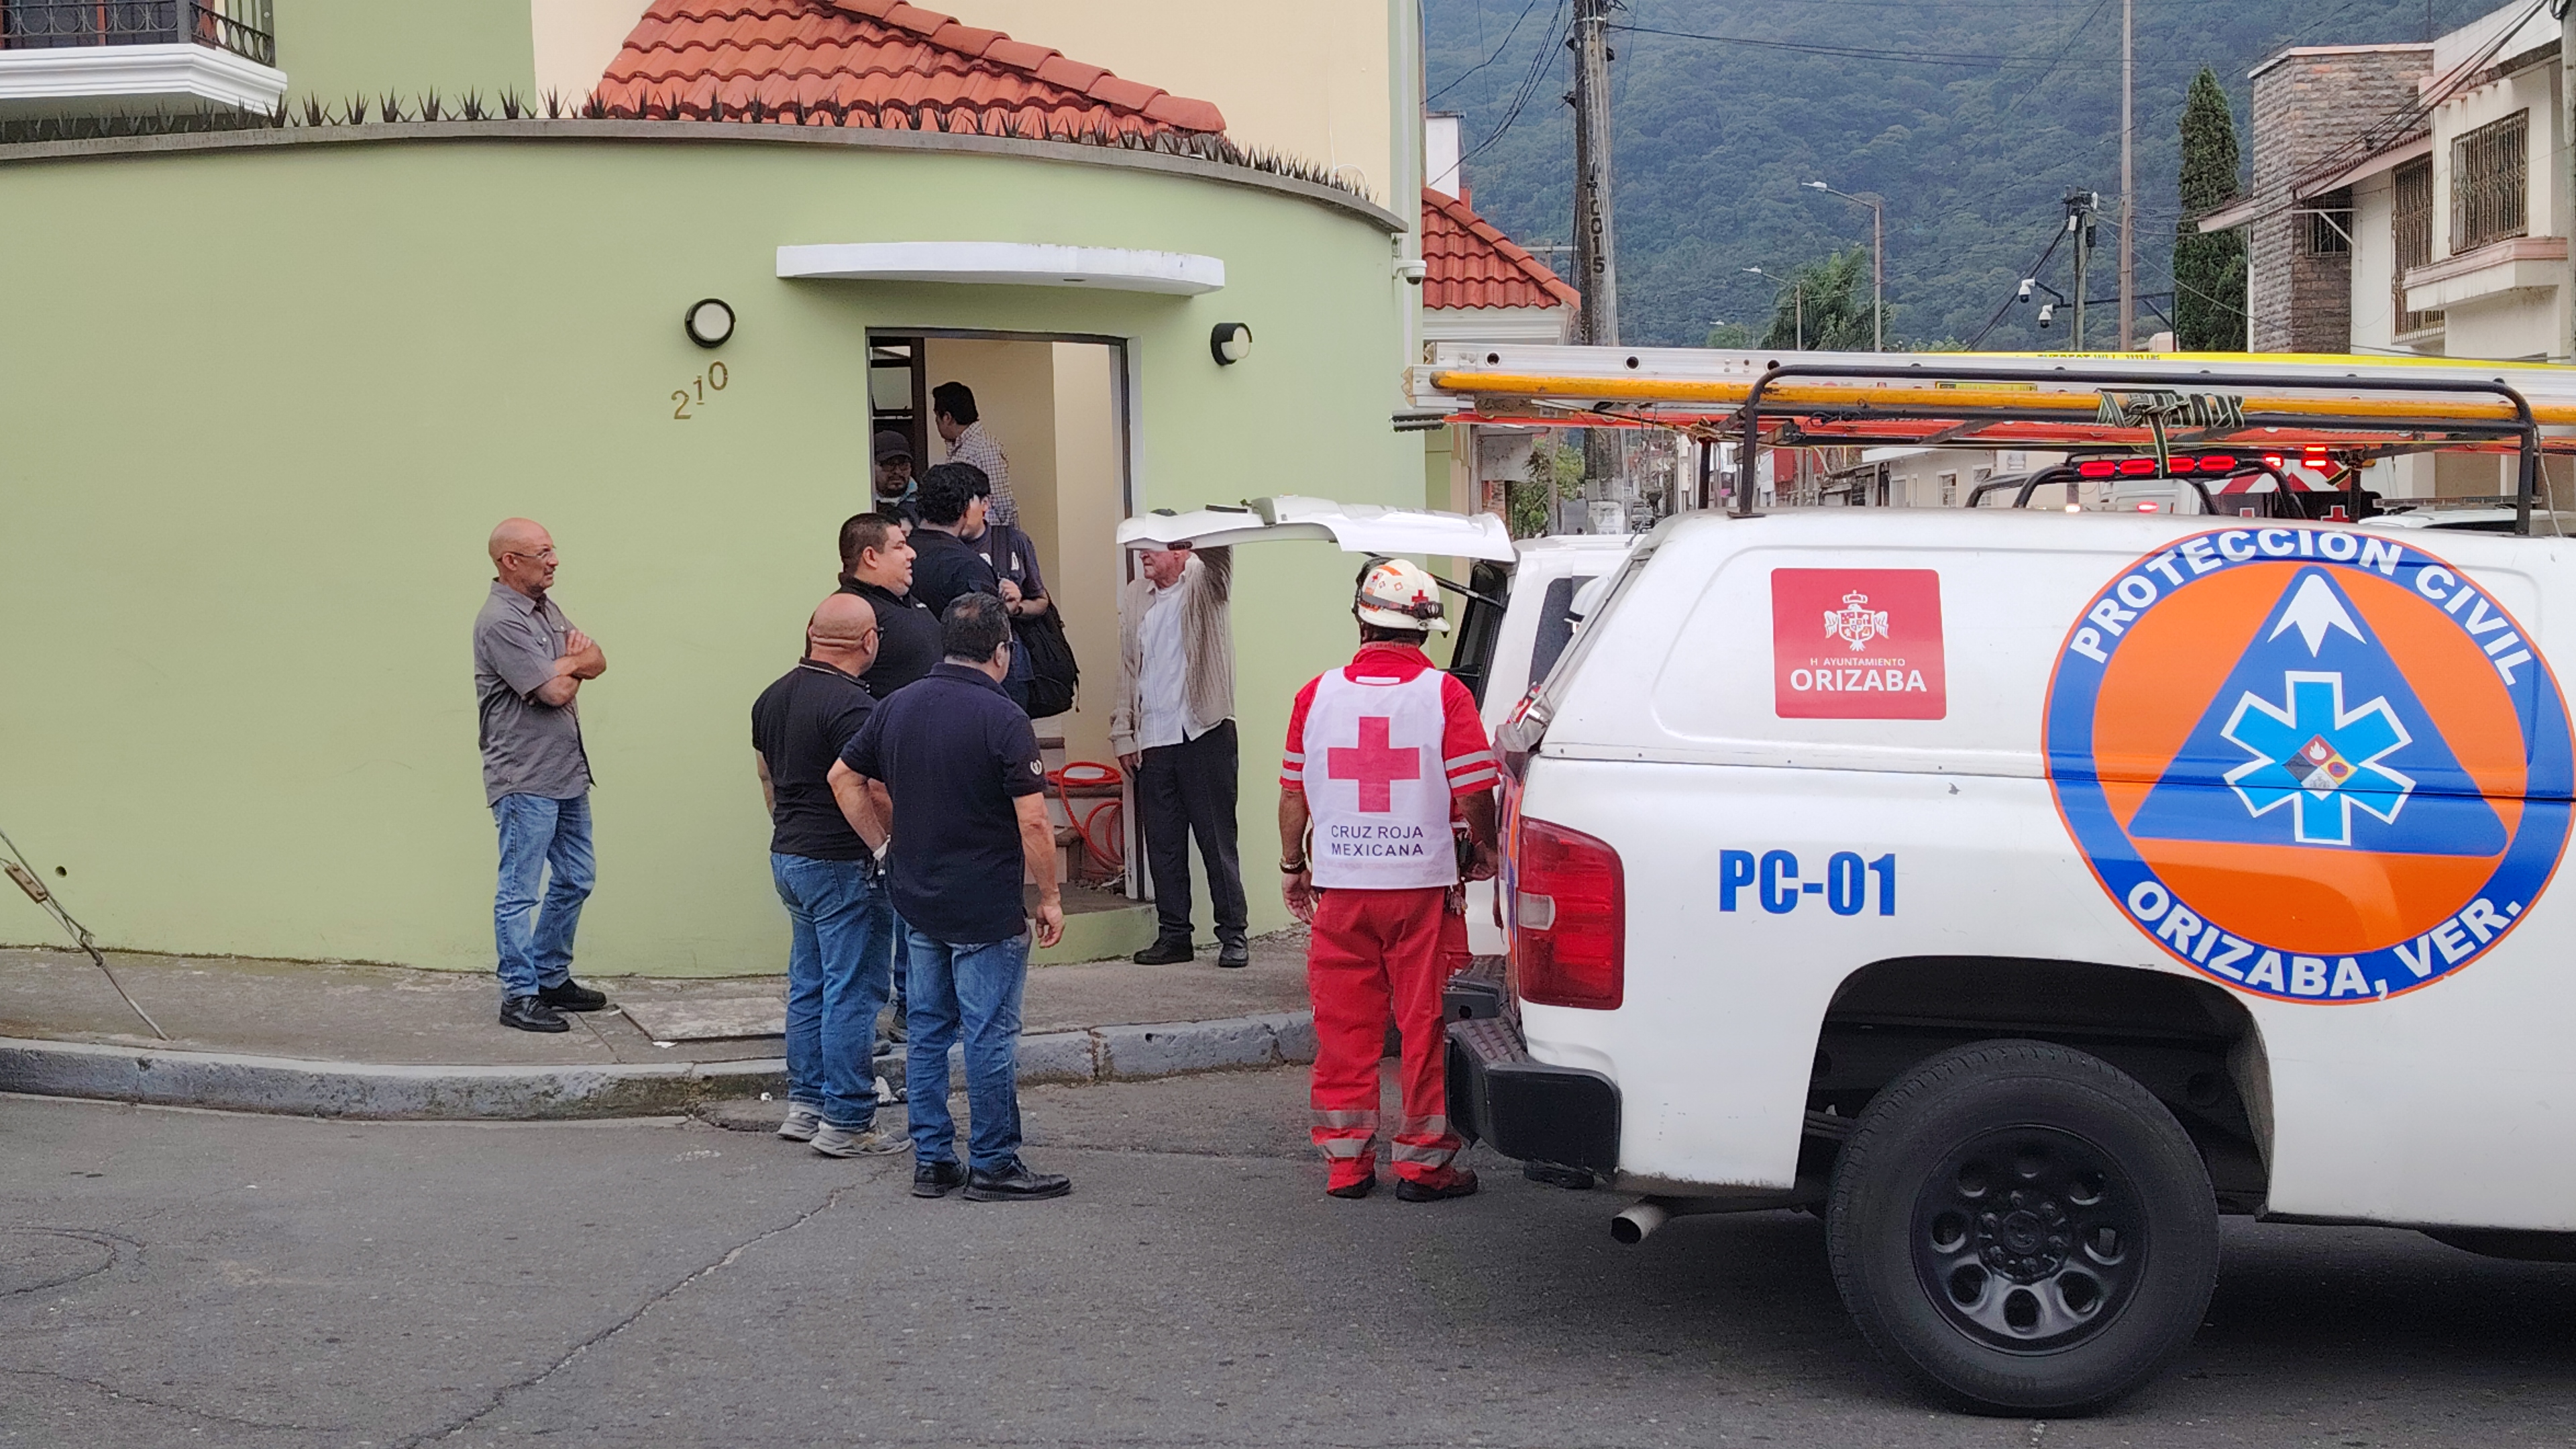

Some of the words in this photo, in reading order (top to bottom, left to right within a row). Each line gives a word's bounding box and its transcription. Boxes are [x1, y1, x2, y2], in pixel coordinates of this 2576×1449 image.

[671, 361, 729, 420] 210
[2416, 565, 2532, 686] CIVIL
[1790, 668, 1927, 692] ORIZABA
[1823, 657, 1906, 667] AYUNTAMIENTO
[1331, 824, 1373, 839] CRUZ
[1378, 826, 1424, 839] ROJA
[1331, 843, 1424, 857] MEXICANA
[1719, 849, 1896, 917] PC-01
[2127, 880, 2389, 1002] ORIZABA,
[2392, 898, 2522, 978] VER.
